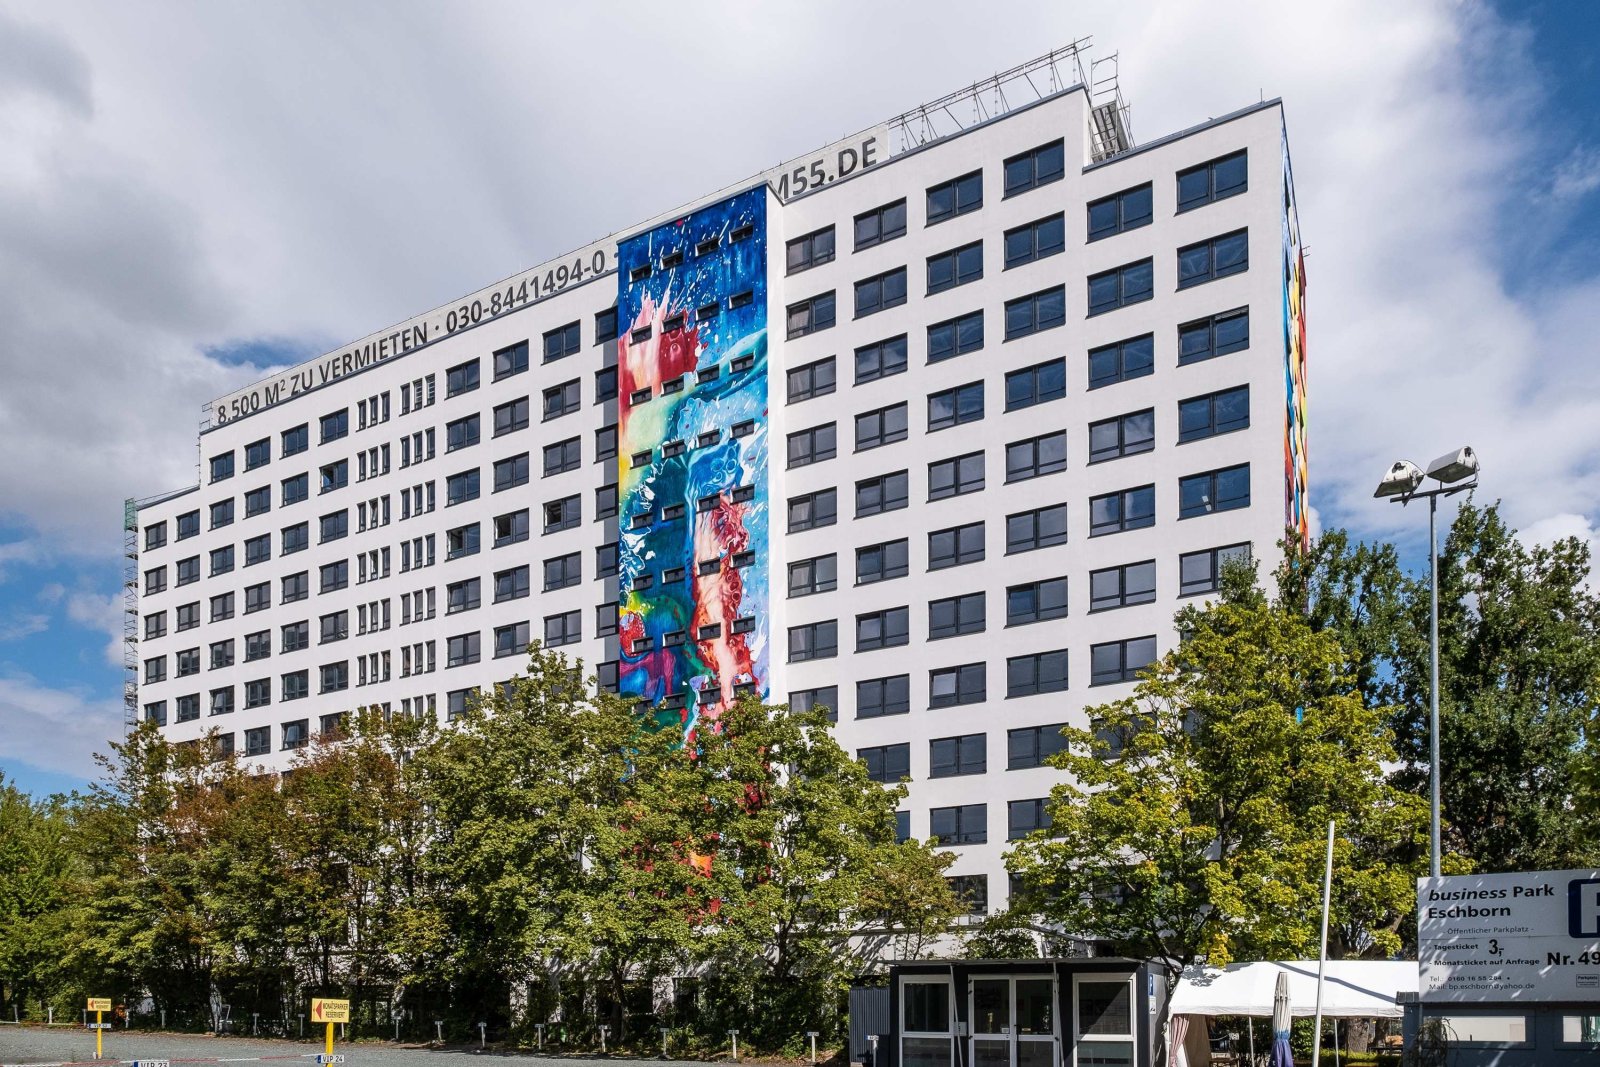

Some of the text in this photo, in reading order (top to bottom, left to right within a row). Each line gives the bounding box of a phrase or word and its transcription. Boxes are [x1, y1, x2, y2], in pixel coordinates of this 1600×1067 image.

[217, 391, 260, 424] 8.500
[290, 368, 313, 396] ZU
[319, 322, 427, 382] VERMIETEN
[446, 250, 605, 333] 030-8441494-0
[1428, 884, 1555, 901] business Park
[1428, 905, 1511, 919] Eschborn
[1447, 926, 1529, 935] Öffentlicher Parkplatz
[1547, 952, 1575, 965] Nr.
[1448, 983, 1535, 991] bp.eschborn@yahoo.de
